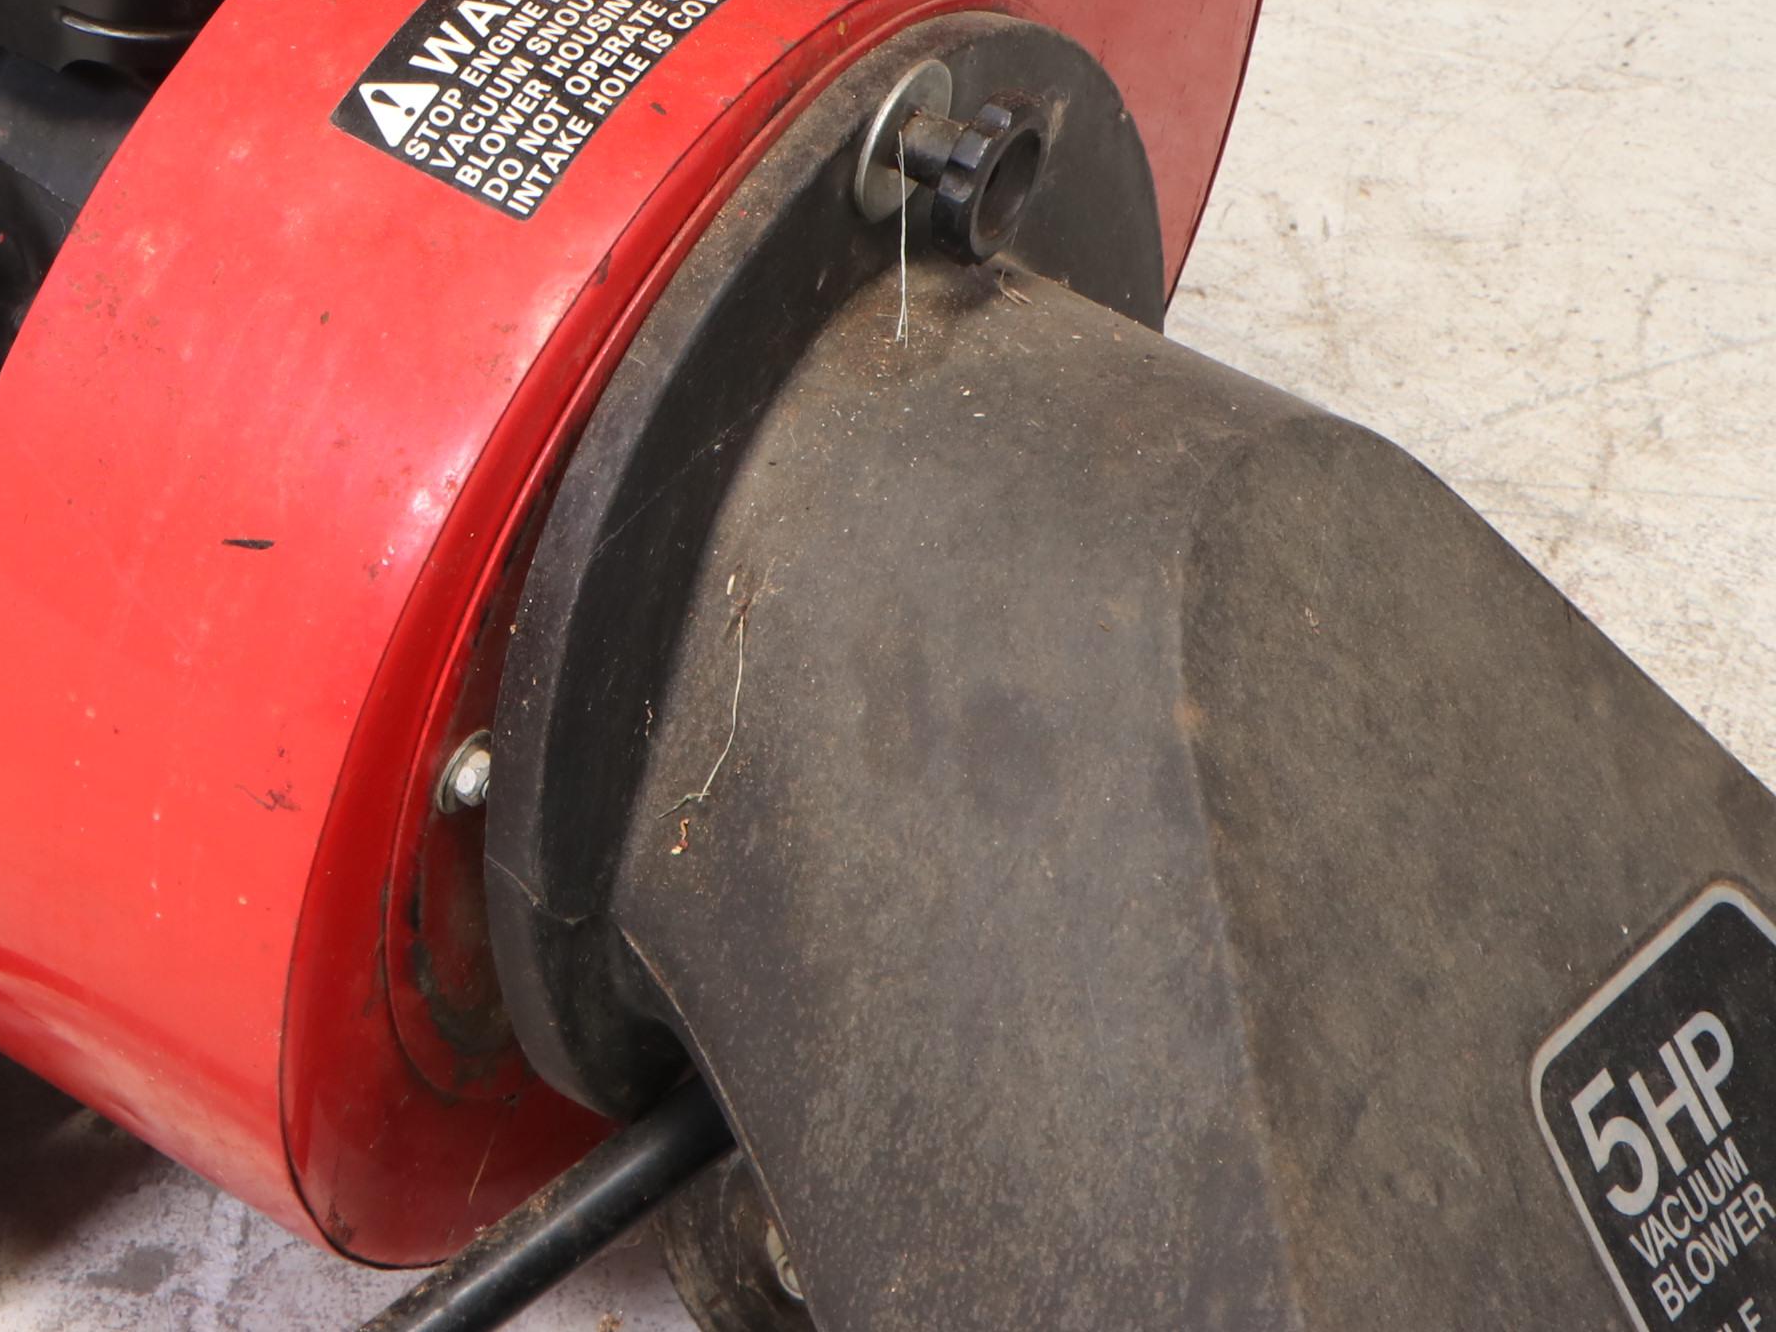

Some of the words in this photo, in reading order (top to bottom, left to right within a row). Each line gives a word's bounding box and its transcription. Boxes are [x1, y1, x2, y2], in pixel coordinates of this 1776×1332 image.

[405, 88, 463, 160] STOP
[459, 1, 548, 88] ENGINE
[429, 55, 534, 168] VACUUM
[455, 78, 552, 188] BLOWER
[482, 158, 524, 201] DO
[516, 96, 570, 155] NOT
[564, 0, 667, 96] OPERATE
[507, 115, 594, 214] INTAKE
[583, 53, 650, 115] HOLE
[641, 29, 673, 54] IS
[1570, 1011, 1734, 1217] 5HP
[1629, 1137, 1749, 1268] VACUUM
[1652, 1183, 1775, 1322] BLOWER
